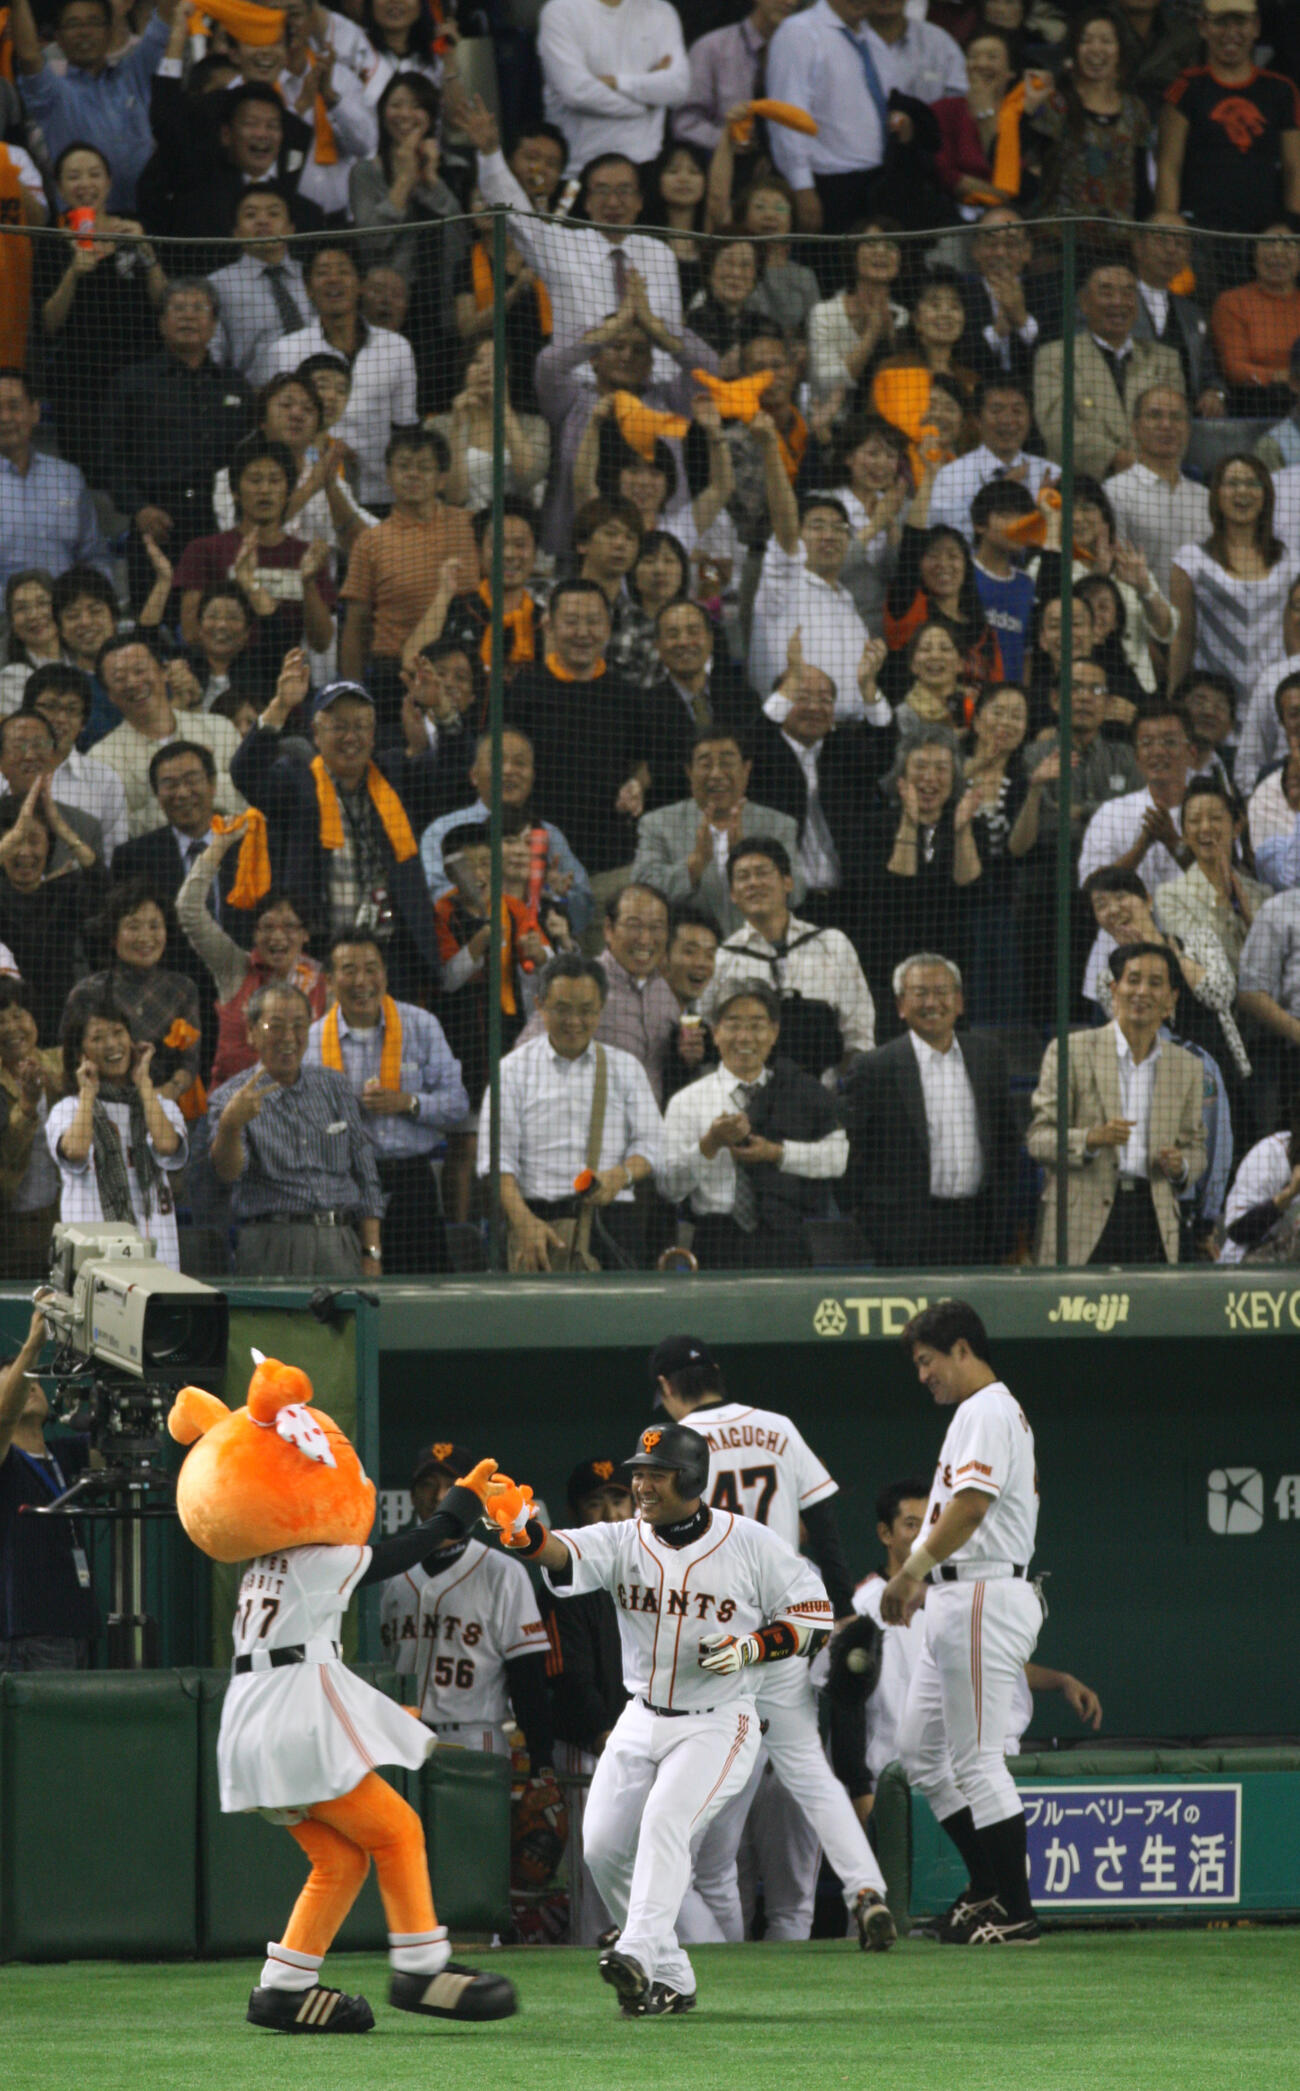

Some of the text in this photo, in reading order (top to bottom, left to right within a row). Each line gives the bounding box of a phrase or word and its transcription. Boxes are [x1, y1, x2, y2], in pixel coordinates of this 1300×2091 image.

[122, 1245, 133, 1258] 4
[845, 1298, 953, 1336] TD
[1048, 1293, 1130, 1332] Meiji
[705, 1426, 789, 1457] MAGUCHI
[710, 1464, 778, 1526] 47
[617, 1583, 737, 1623] GIANTS
[381, 1613, 483, 1648] GIANTS
[434, 1656, 476, 1689] 56
[1023, 1798, 1201, 1827] ブルーベリーアイの
[1026, 1833, 1227, 1893] かさ生活
